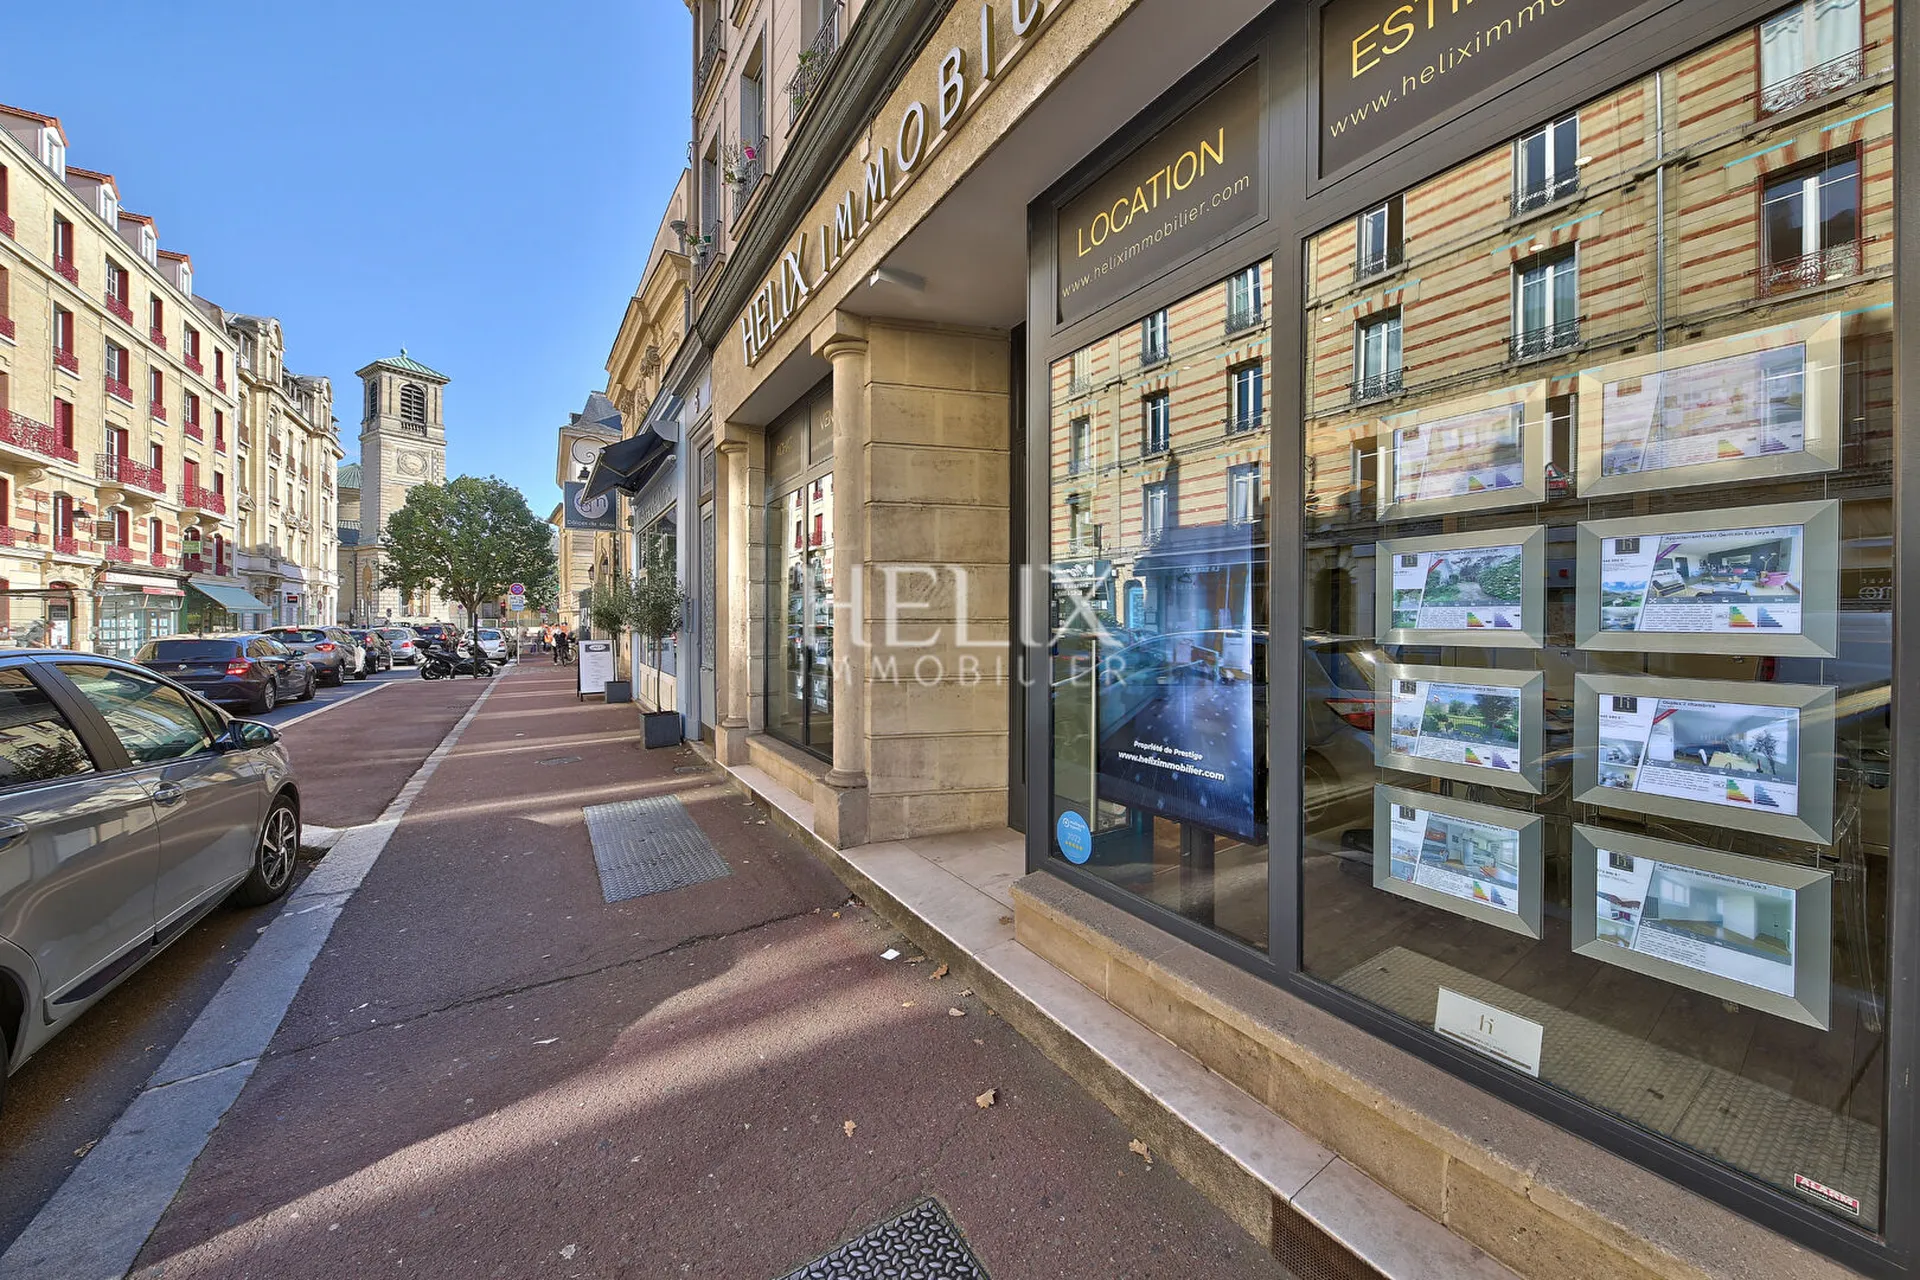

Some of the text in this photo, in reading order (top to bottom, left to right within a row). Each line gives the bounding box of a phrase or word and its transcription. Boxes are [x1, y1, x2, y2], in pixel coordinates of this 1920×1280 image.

[1330, 0, 1566, 138] www.heliximm
[1062, 174, 1250, 298] www.heliximmobilier.com
[1078, 127, 1225, 258] LOCATION
[741, 232, 812, 367] HELIX
[1118, 750, 1225, 781] www.heliximmobilier.com
[1133, 740, 1203, 761] Propriété de Prestige
